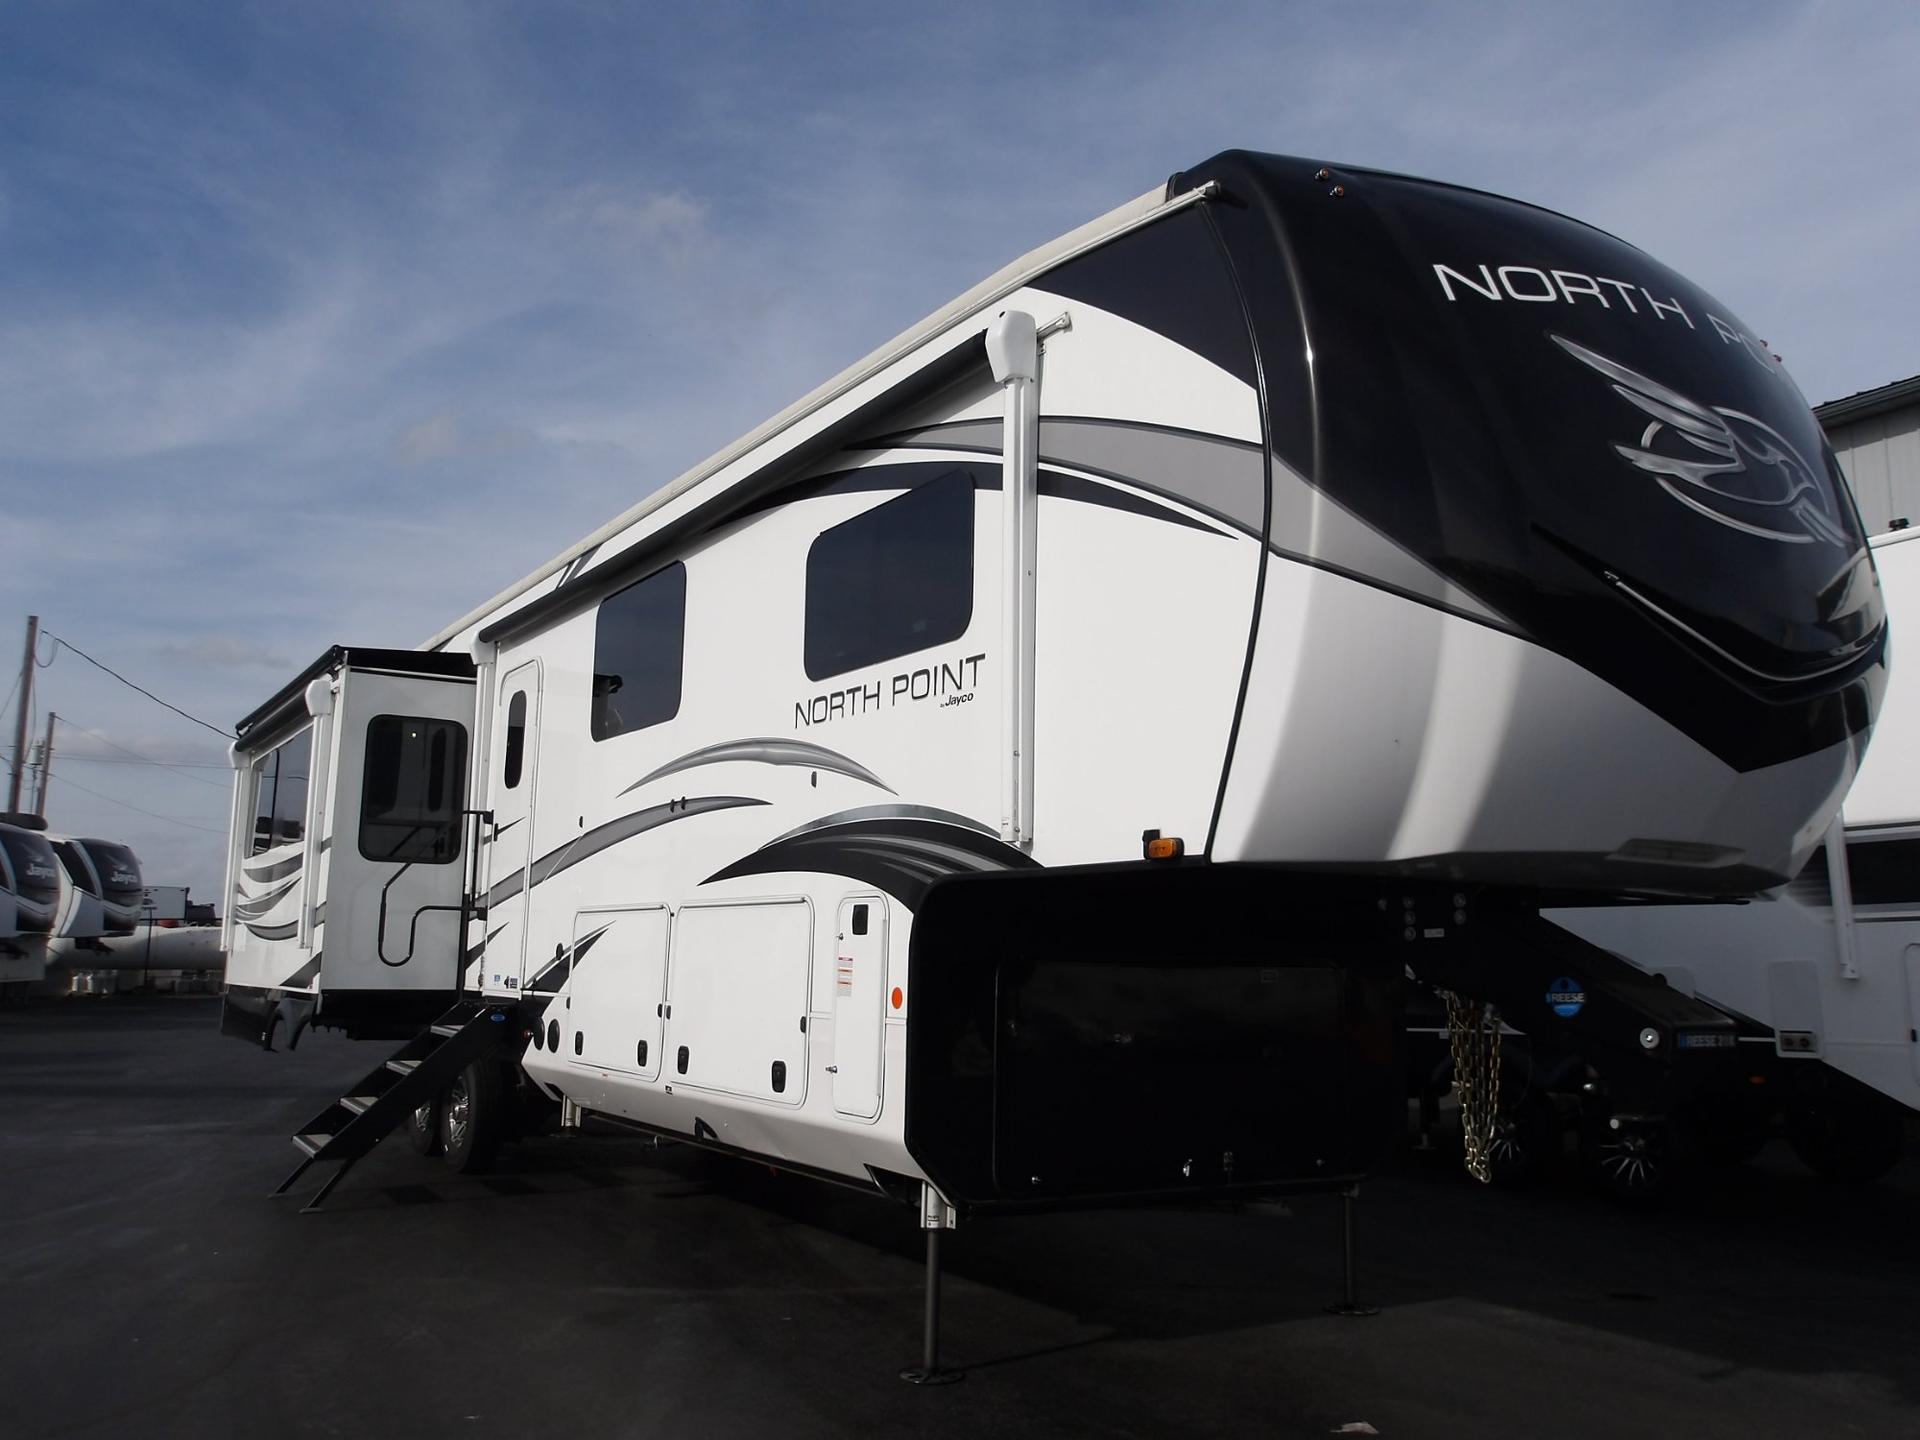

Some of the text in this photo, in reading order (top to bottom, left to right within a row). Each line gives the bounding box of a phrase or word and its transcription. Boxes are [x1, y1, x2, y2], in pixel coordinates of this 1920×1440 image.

[1432, 263, 1695, 330] NORTH
[794, 653, 986, 729] NORTH POINT
[945, 692, 974, 707] Jayco
[1552, 992, 1586, 1003] REESE
